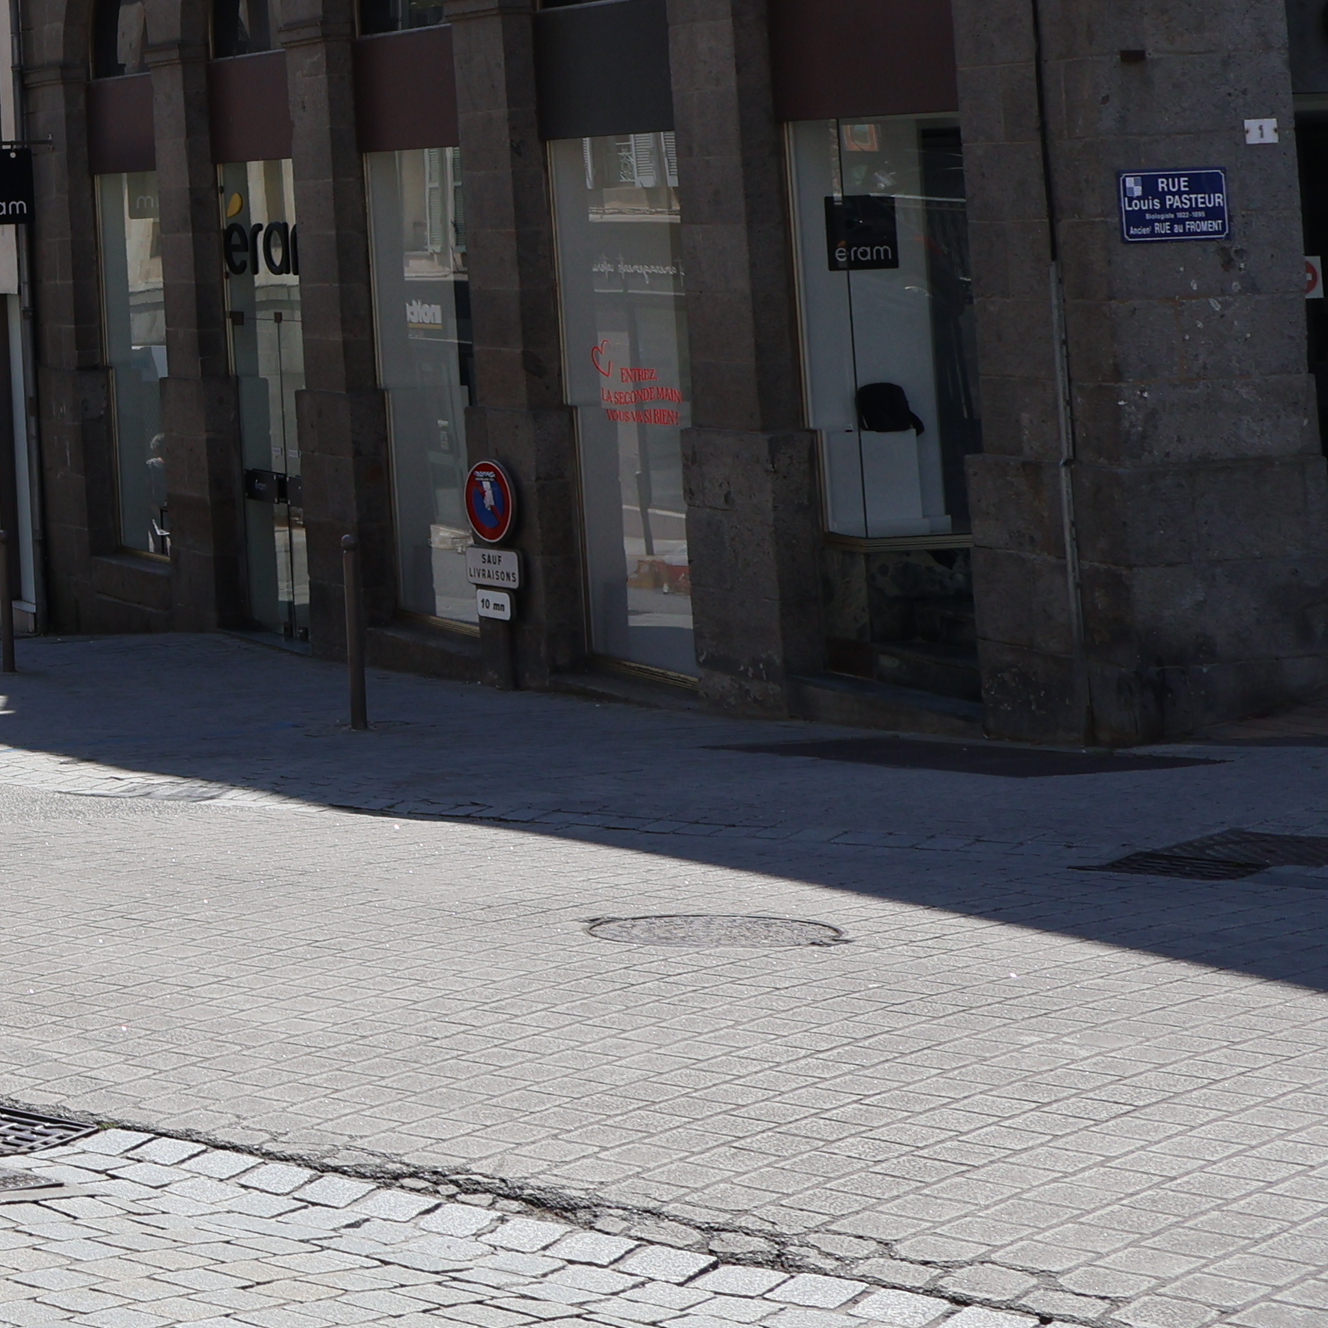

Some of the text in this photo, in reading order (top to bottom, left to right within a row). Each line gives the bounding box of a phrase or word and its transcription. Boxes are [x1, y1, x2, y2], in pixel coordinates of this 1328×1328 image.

[1157, 177, 1189, 192] RUE
[1125, 193, 1224, 211] Louis PASTEUR
[1154, 222, 1171, 234] RUE
[1174, 224, 1183, 233] au
[1185, 220, 1223, 232] FROMENT
[834, 240, 892, 262] éram
[601, 386, 684, 405] LA SECONDE MAIN
[606, 408, 631, 423] VOUS
[631, 410, 644, 423] VA
[644, 409, 654, 424] SI
[481, 553, 503, 566] SAUF
[468, 566, 517, 583] LIVRAISONS
[480, 598, 505, 612] 10 mn
